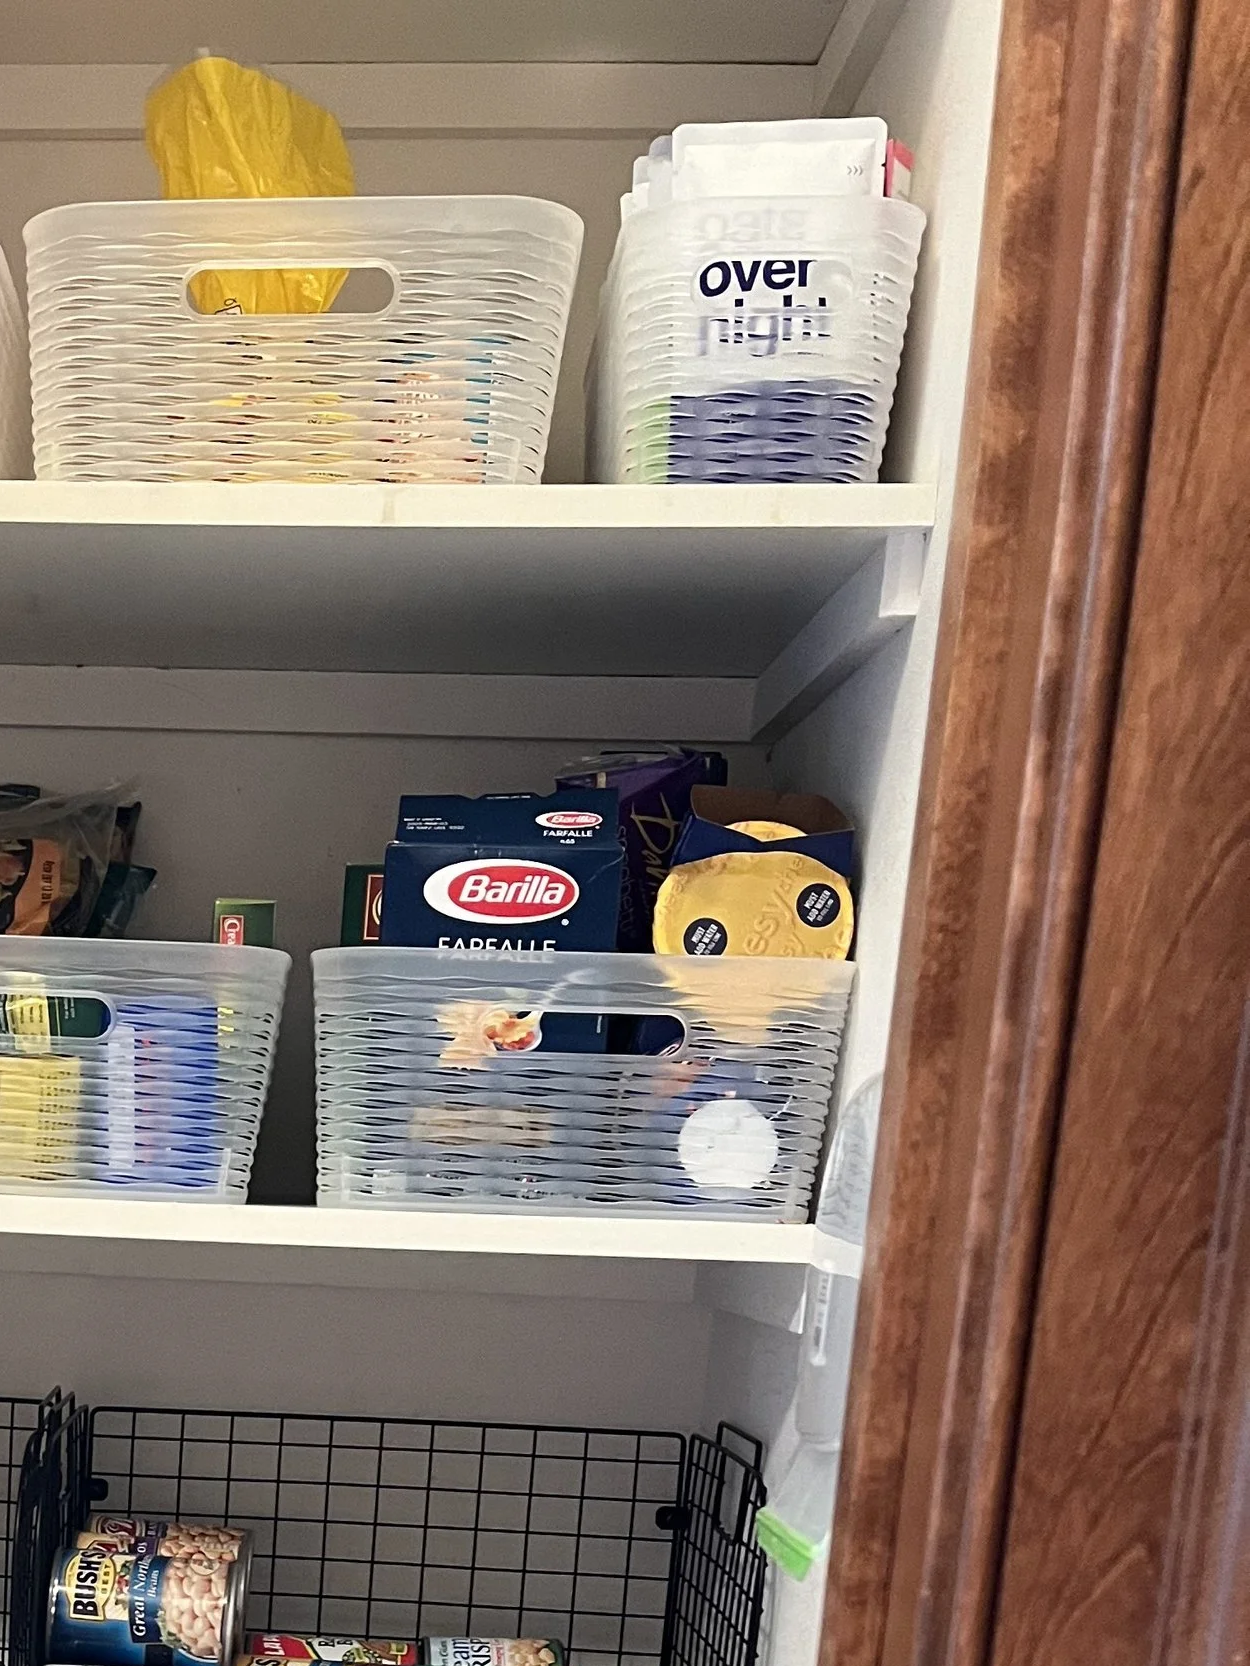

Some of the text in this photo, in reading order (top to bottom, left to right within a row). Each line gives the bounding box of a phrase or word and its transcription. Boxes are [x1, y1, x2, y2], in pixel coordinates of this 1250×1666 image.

[699, 259, 818, 297] over
[543, 829, 593, 838] FARFALLE
[549, 815, 598, 824] Barilla
[459, 874, 567, 905] Barilla
[438, 936, 557, 961] FARFALLE
[132, 1596, 146, 1637] Great
